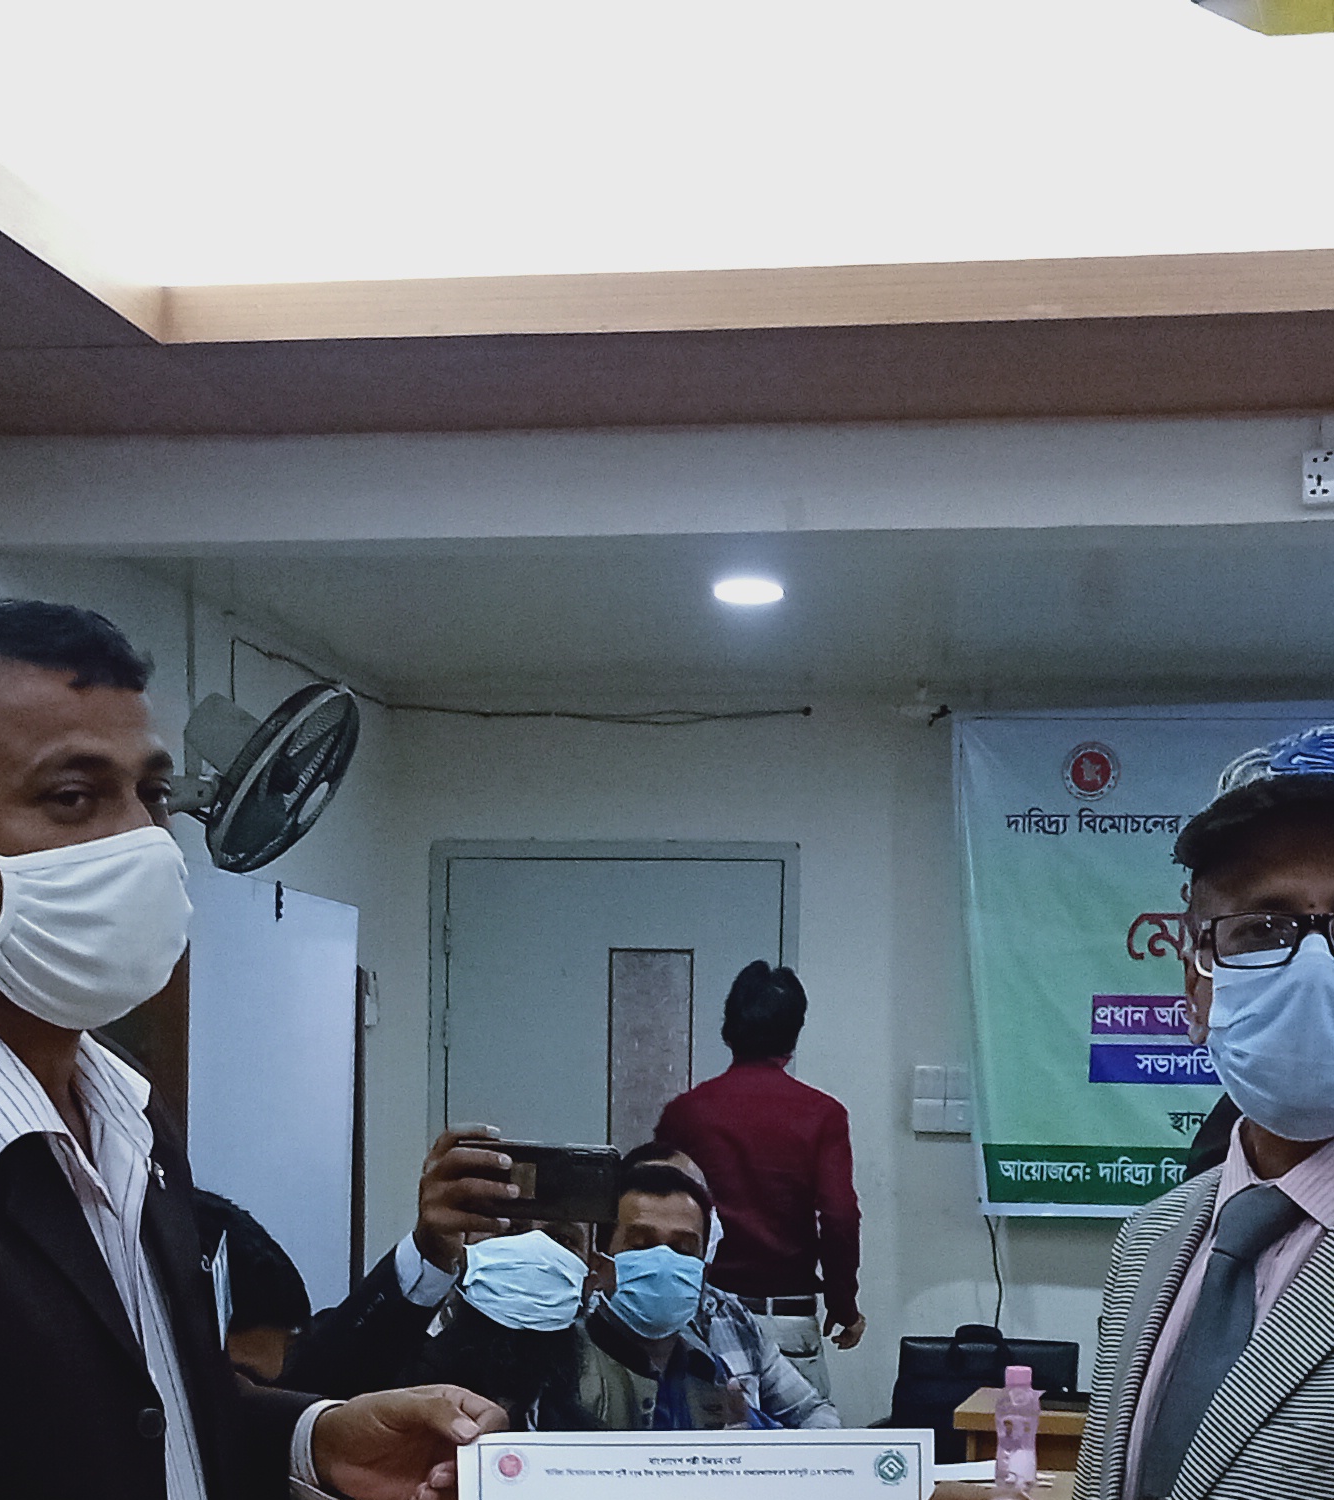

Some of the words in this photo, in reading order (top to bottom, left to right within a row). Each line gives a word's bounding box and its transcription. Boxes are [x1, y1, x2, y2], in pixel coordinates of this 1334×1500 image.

[1006, 807, 1070, 836] দারিদ্র্য
[1078, 807, 1182, 835] বিমোচনের
[1094, 1004, 1149, 1028] প্রধান
[1153, 1000, 1190, 1027] অতি
[1135, 1047, 1216, 1076] সভাপতি
[1096, 1155, 1156, 1187] দারিদ্র্য
